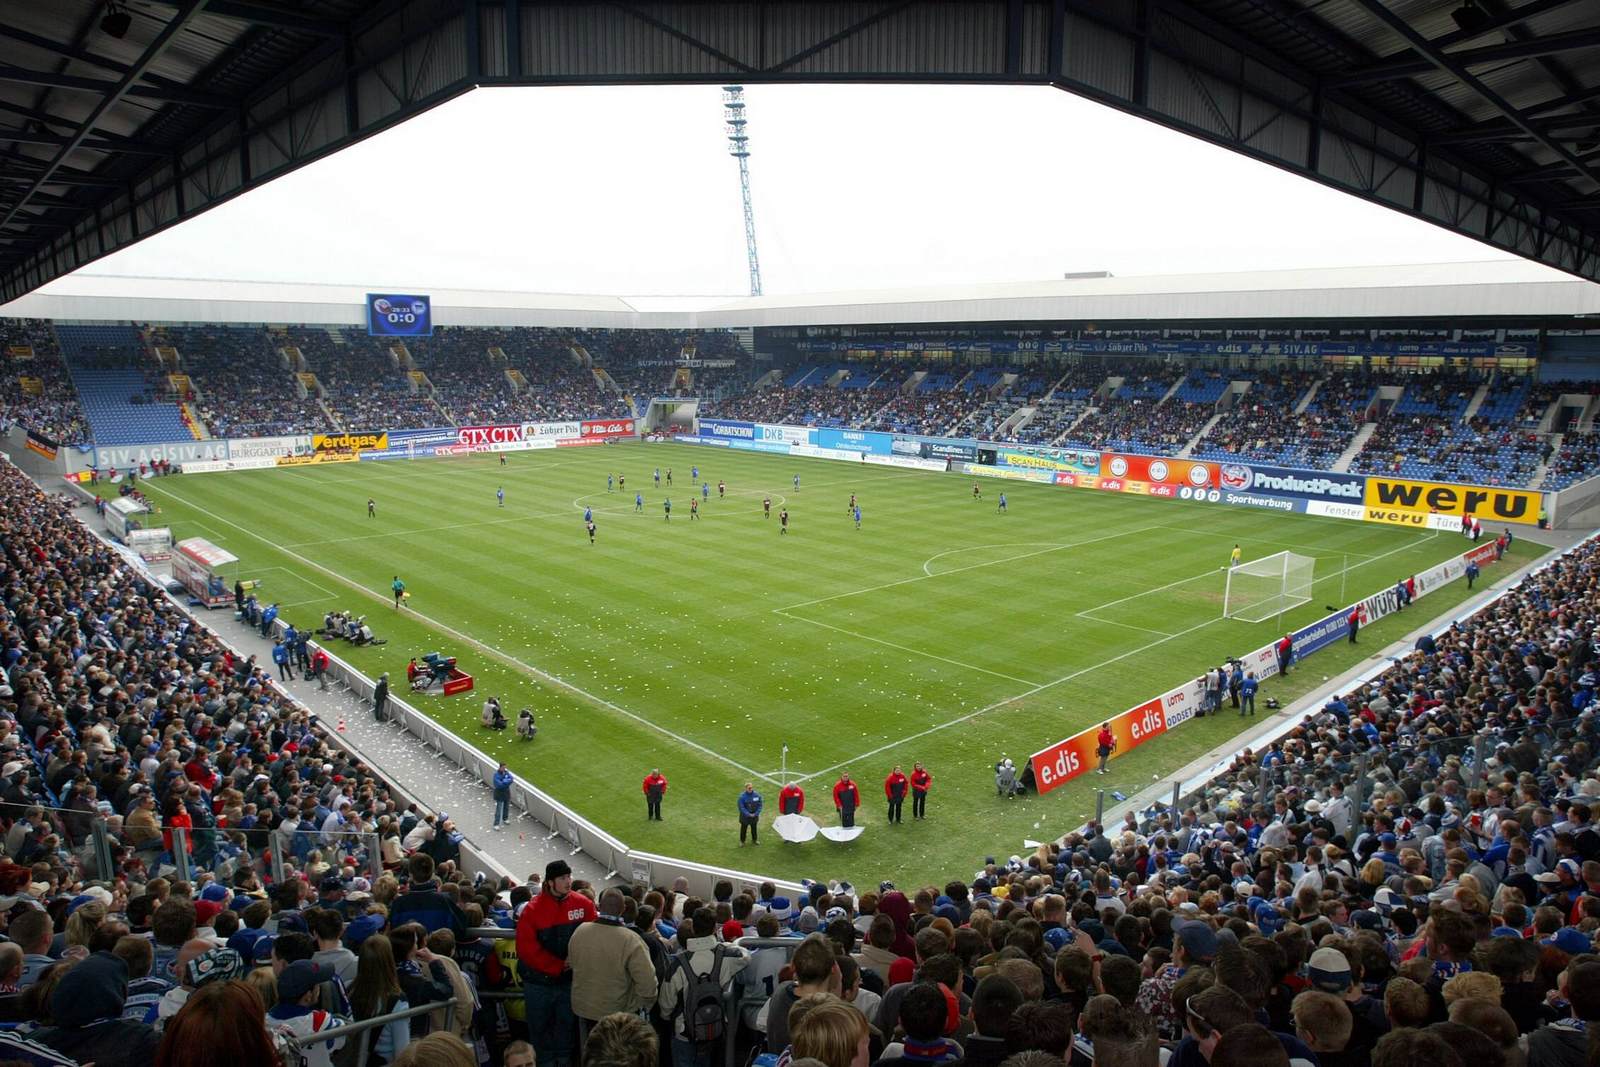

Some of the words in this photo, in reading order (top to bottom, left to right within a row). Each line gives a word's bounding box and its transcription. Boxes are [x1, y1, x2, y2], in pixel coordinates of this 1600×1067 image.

[388, 313, 415, 323] 0:0
[323, 434, 377, 451] erdgas
[491, 427, 521, 443] CTX
[765, 428, 783, 441] DKB
[100, 450, 129, 466] SIV
[168, 447, 196, 461] SIV
[205, 444, 226, 459] AG
[1101, 480, 1121, 490] e.dis
[1150, 486, 1170, 496] e.dis
[1253, 472, 1363, 498] ProductPack
[1226, 493, 1293, 510] Sportwerbung
[1377, 482, 1528, 518] weru
[1325, 504, 1362, 517] Fenster
[1369, 510, 1424, 524] weru
[1167, 692, 1184, 708] LOTTO
[1131, 709, 1162, 740] e.dis
[1167, 707, 1193, 727] ODDSET
[1041, 749, 1080, 785] e.dis
[567, 908, 585, 921] 666
